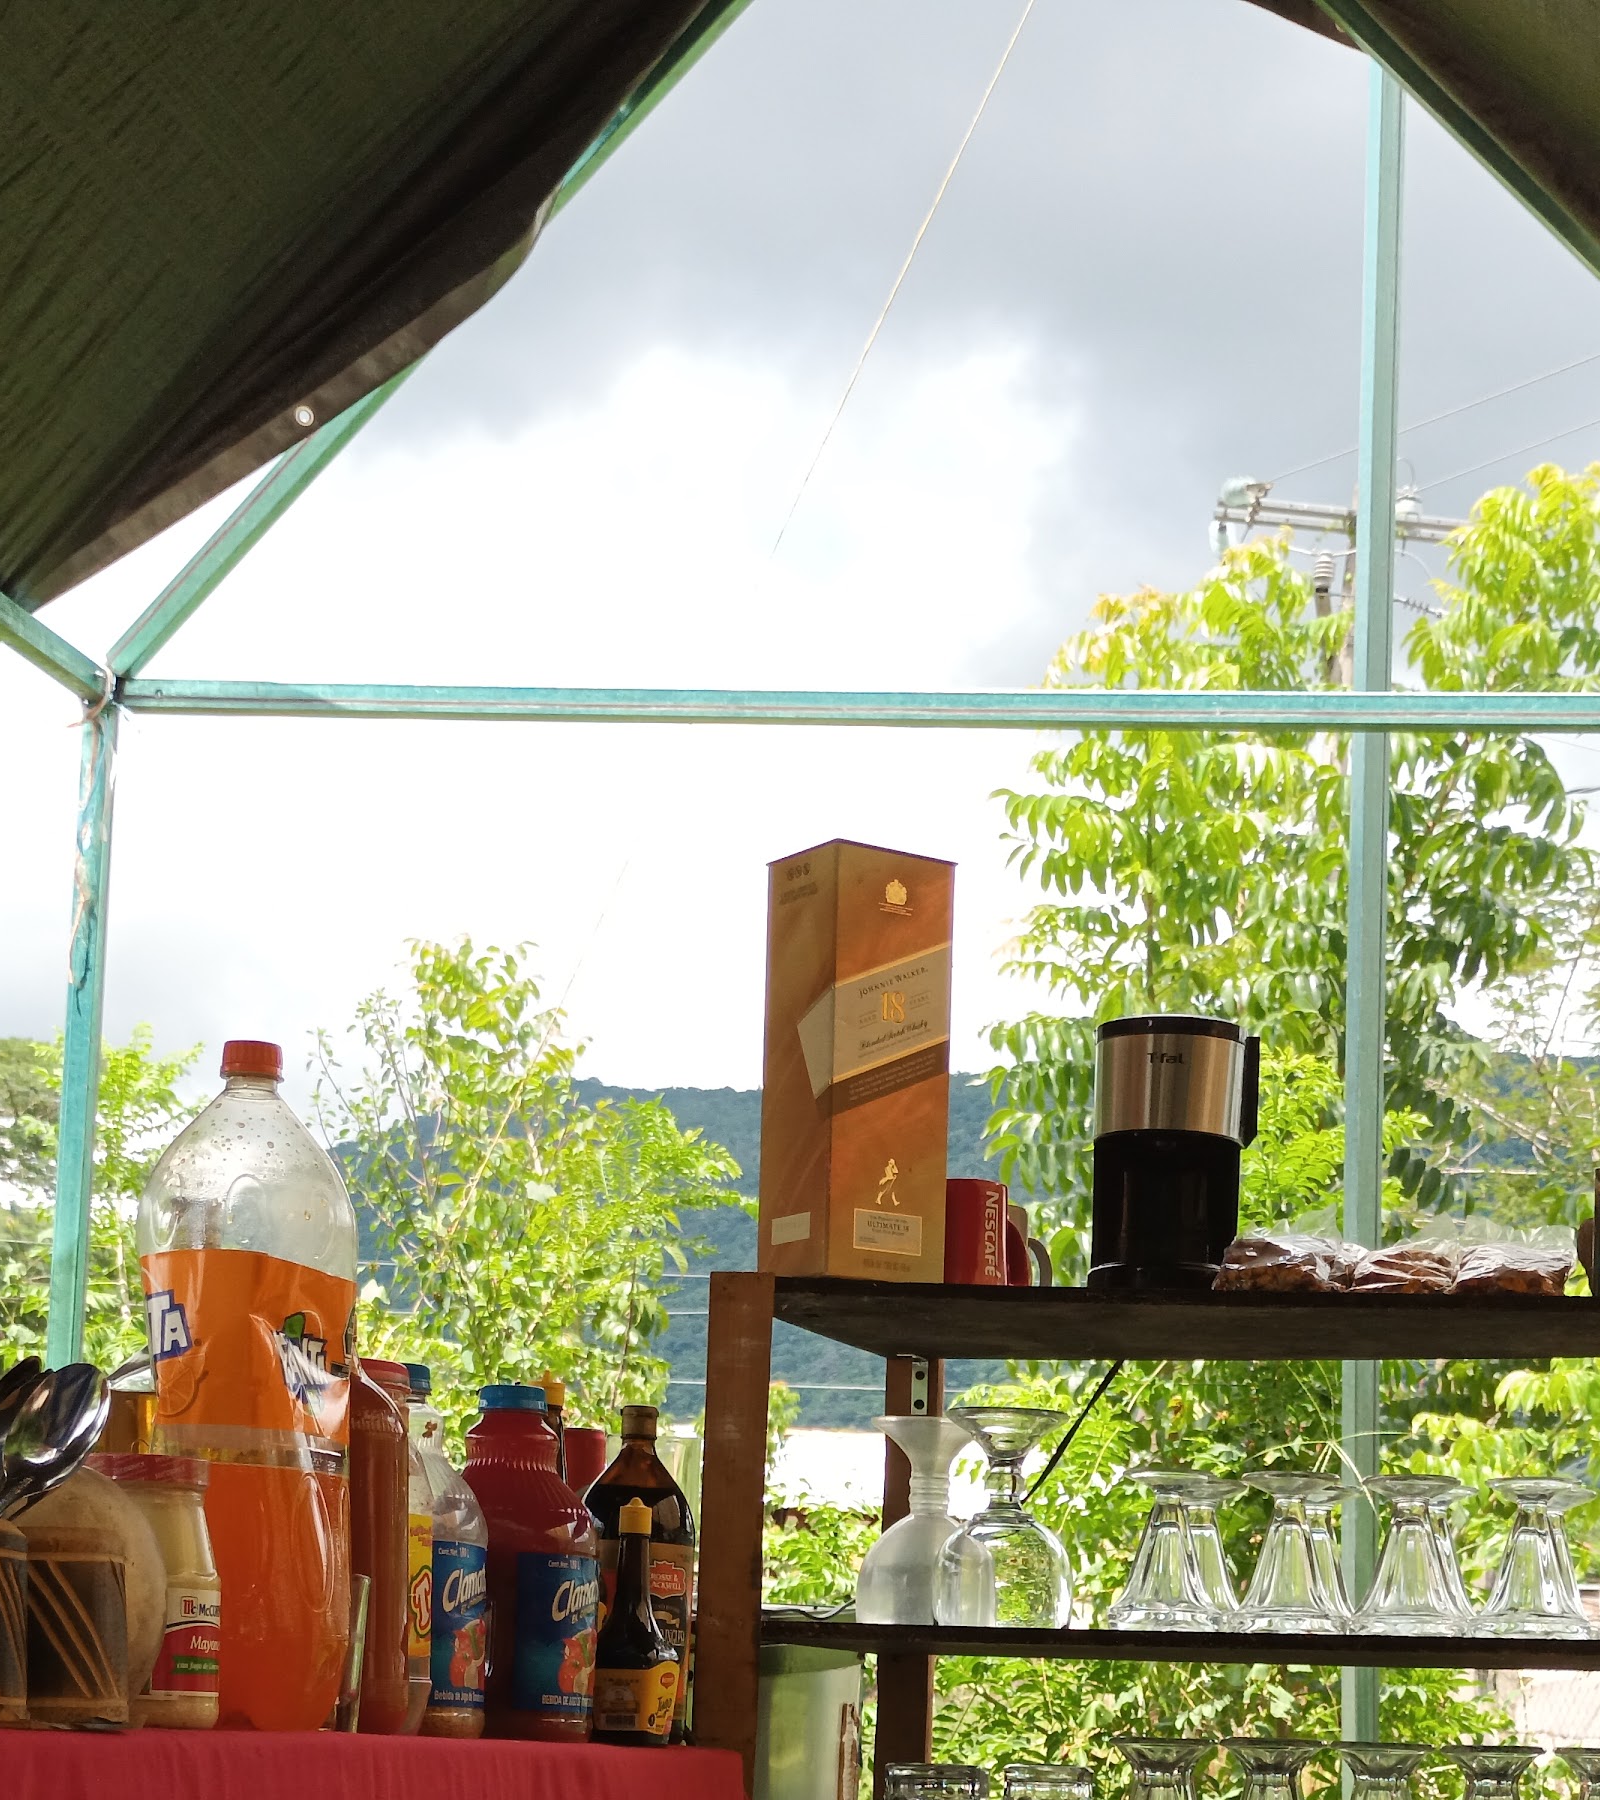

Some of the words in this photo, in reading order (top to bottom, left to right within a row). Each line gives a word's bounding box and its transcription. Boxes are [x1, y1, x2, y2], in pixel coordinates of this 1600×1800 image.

[858, 979, 894, 998] JOHNNIE
[894, 966, 926, 983] WALKER
[881, 991, 905, 1023] 18
[984, 1190, 1002, 1280] NESCAFÉ
